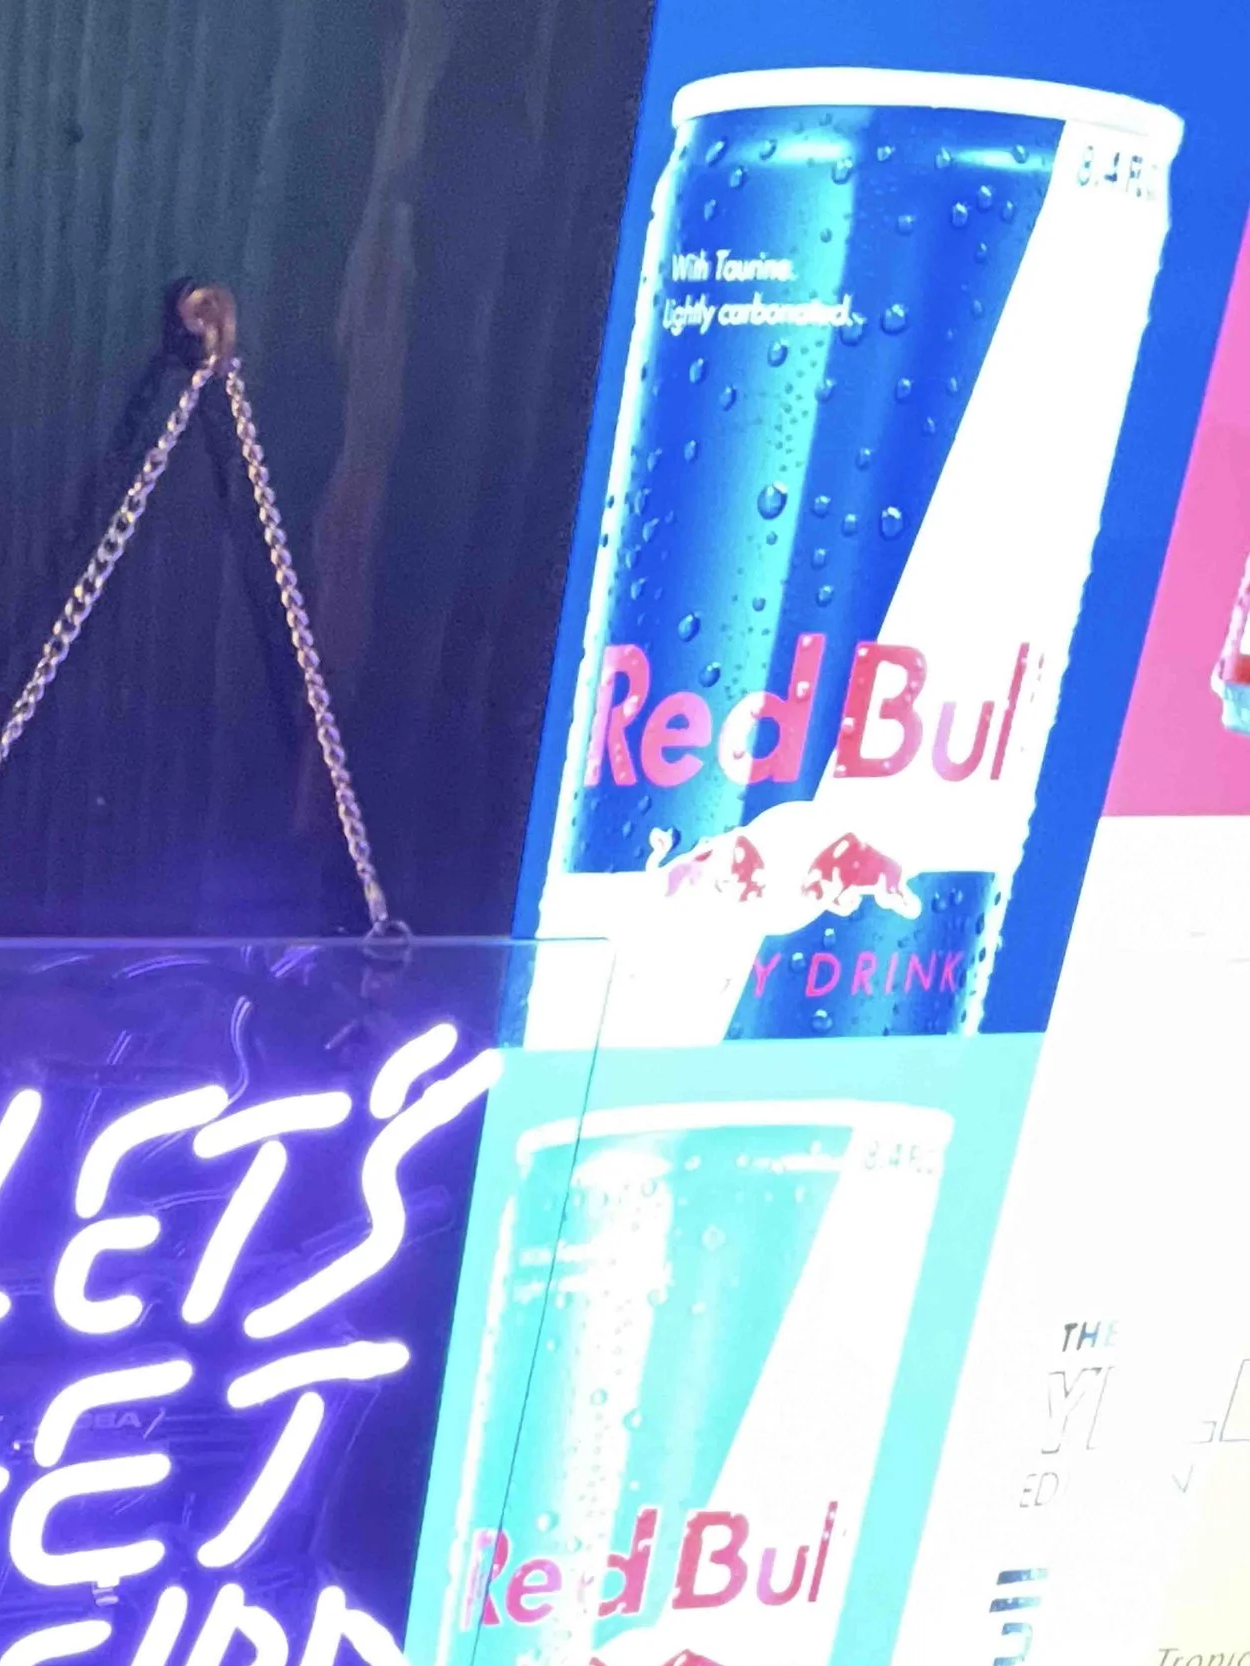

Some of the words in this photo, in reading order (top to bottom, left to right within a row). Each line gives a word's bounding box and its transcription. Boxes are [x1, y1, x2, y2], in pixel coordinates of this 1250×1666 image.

[672, 249, 709, 282] With
[584, 633, 826, 787] Red
[805, 951, 964, 998] DRINK
[1061, 1320, 1119, 1352] THE
[462, 1508, 658, 1630] Red
